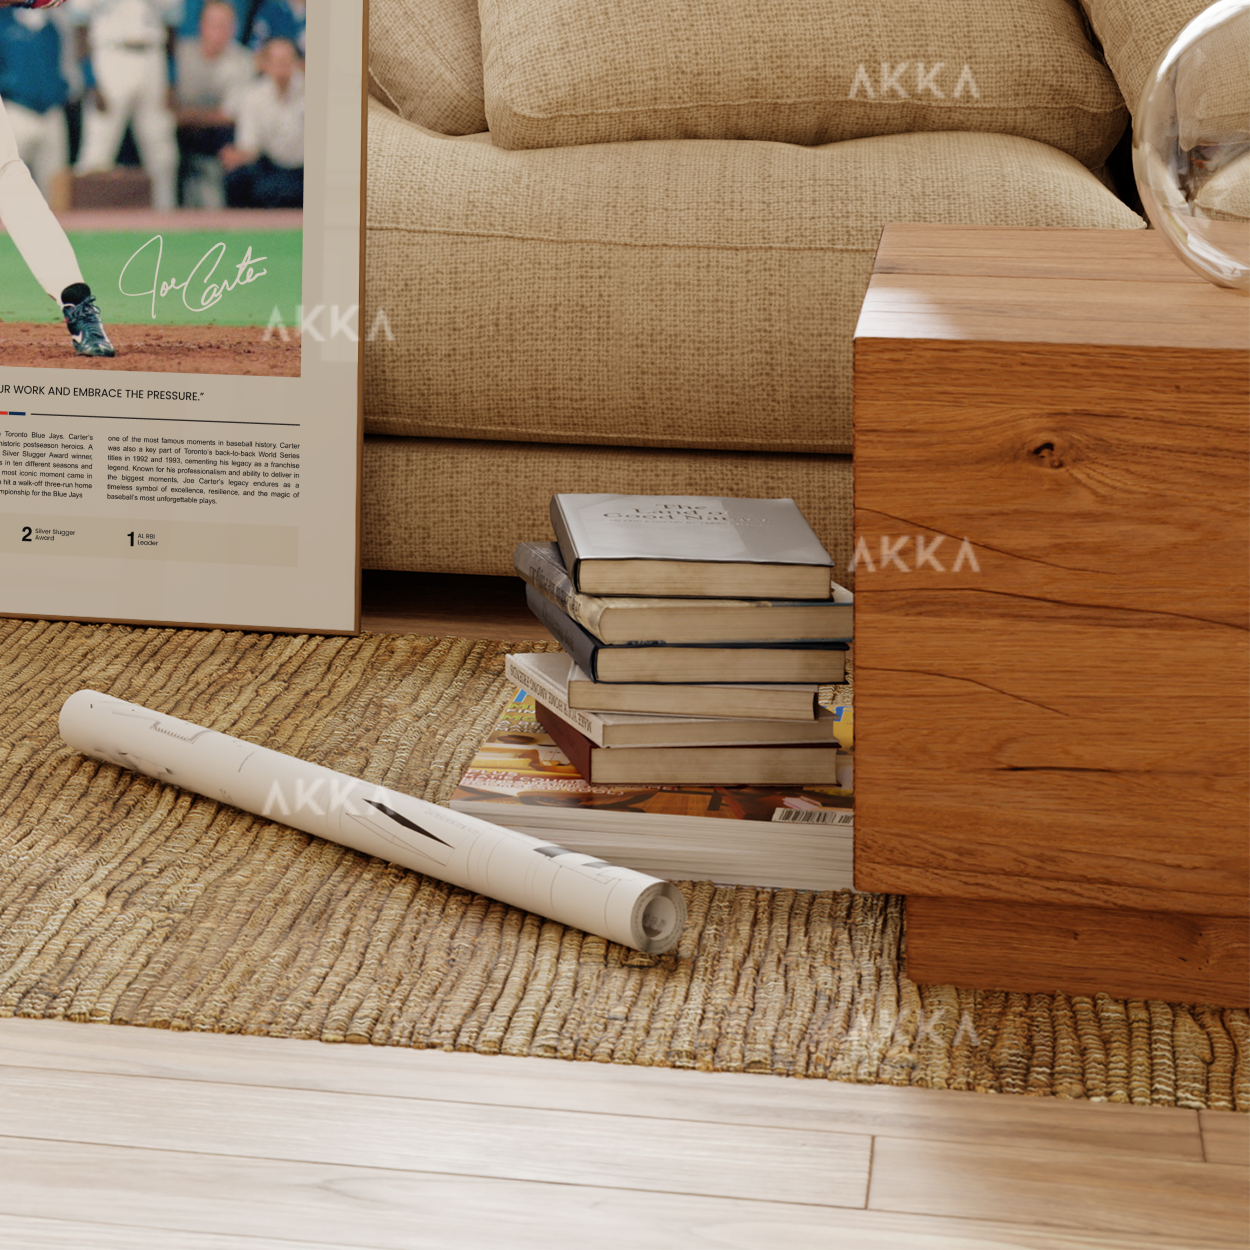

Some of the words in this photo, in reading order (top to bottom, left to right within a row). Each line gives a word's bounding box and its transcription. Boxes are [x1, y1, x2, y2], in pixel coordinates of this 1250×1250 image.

[119, 235, 184, 319] Joe
[183, 242, 267, 312] Carter
[13, 384, 45, 395] WORK
[47, 386, 70, 395] AND
[73, 387, 122, 398] EMBRACE
[124, 389, 144, 399] THE
[146, 389, 204, 401] PRESSURE.”
[4, 430, 28, 438] Toronto
[31, 431, 45, 439] Blue
[48, 432, 64, 441] Jays.
[68, 433, 93, 441] Carter's
[106, 492, 138, 500] baseball's
[156, 495, 198, 503] unforgettable
[198, 497, 217, 505] plays.
[21, 525, 32, 541] 2
[34, 527, 51, 536] Silver
[52, 528, 75, 536] Slugger
[126, 531, 134, 546] 1
